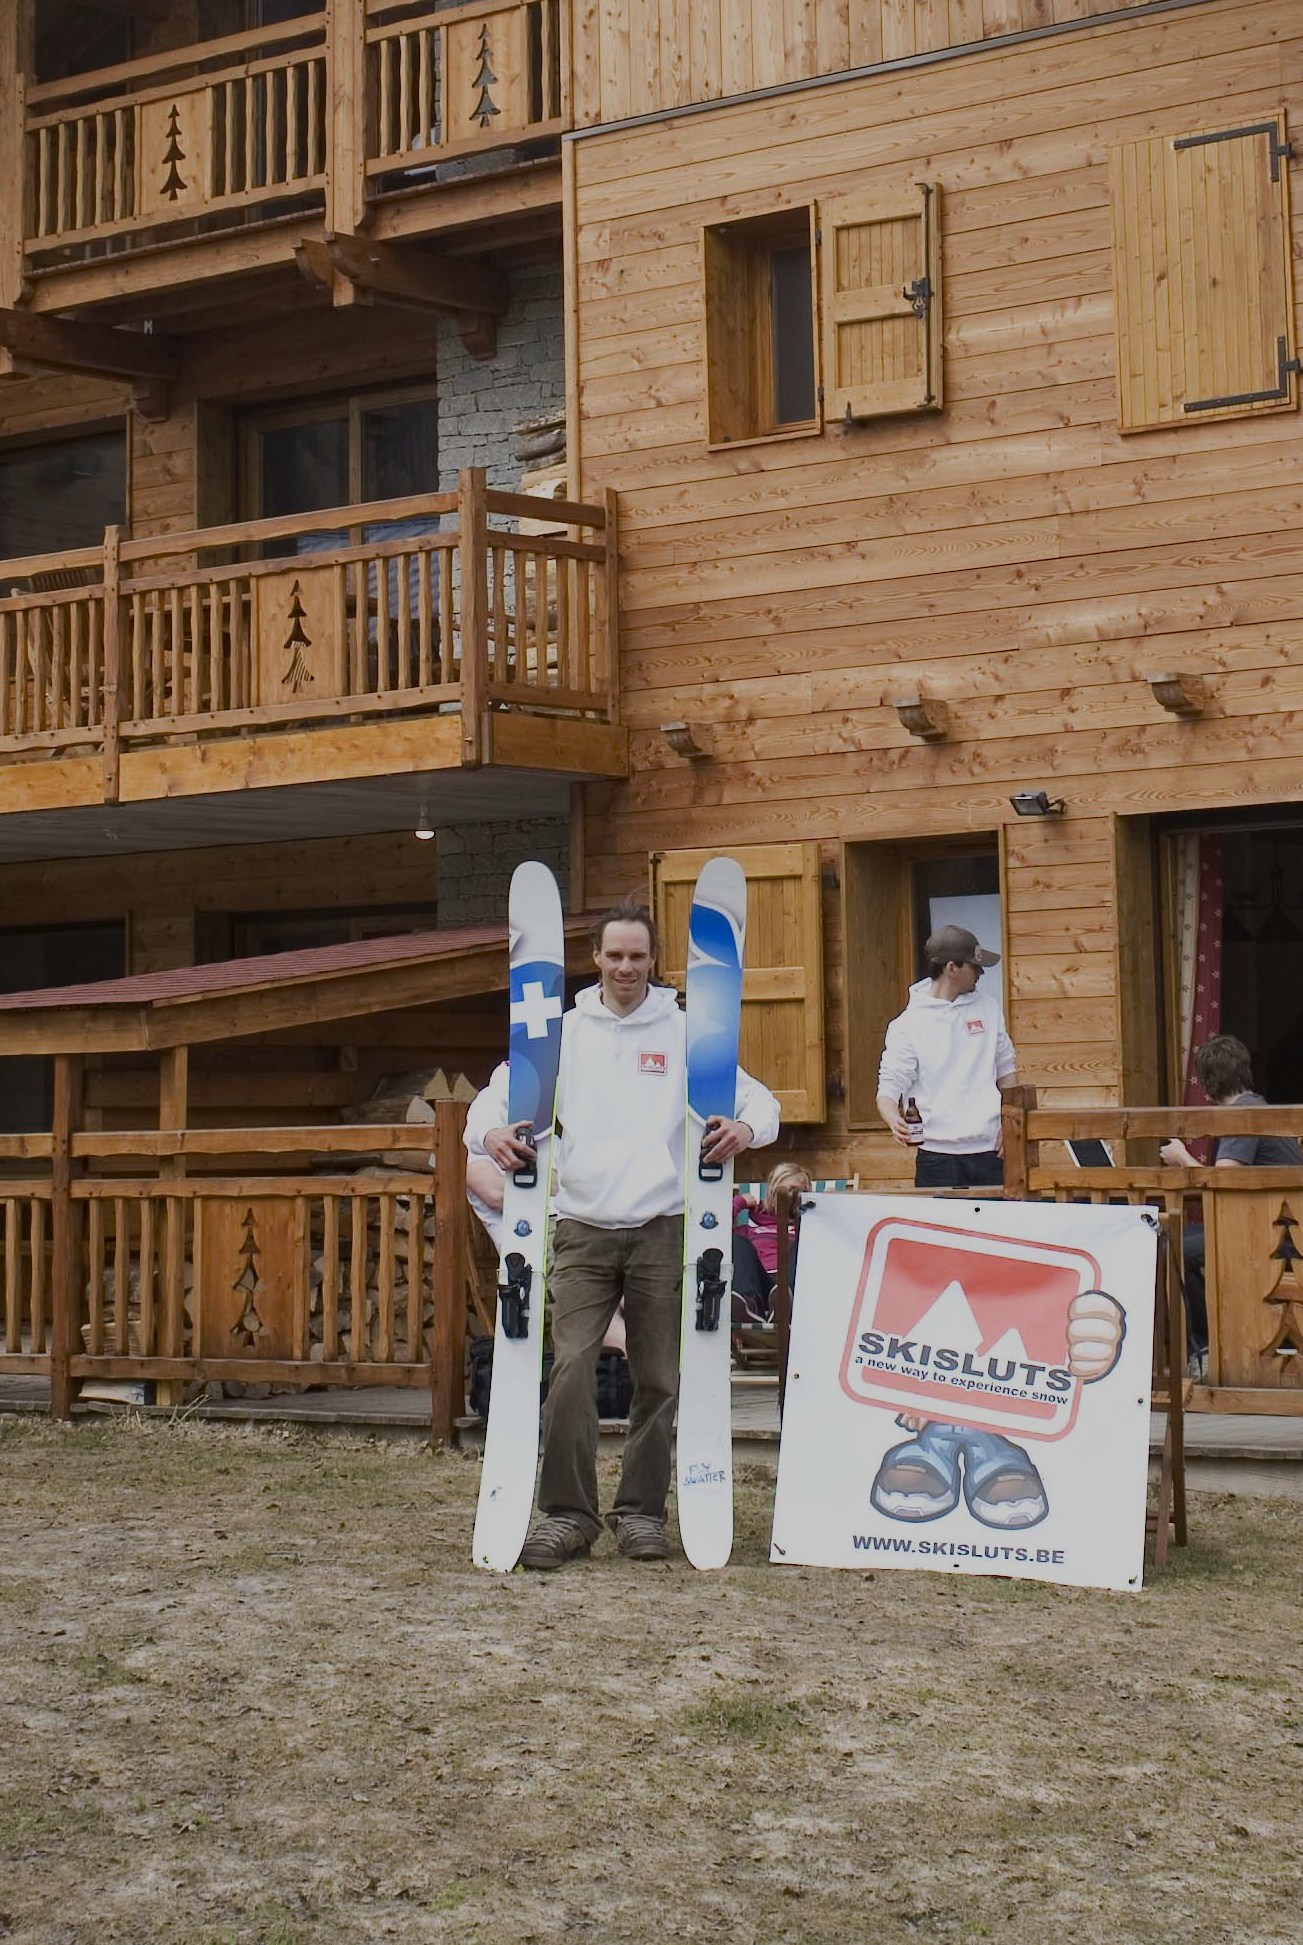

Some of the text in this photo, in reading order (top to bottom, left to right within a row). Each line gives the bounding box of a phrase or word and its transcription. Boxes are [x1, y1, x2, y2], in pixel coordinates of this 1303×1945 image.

[855, 1356, 1068, 1405] a new way to experience snow
[859, 1332, 1072, 1392] SKISLUTS
[852, 1535, 1065, 1564] WWW.SKISLUTS.BE
